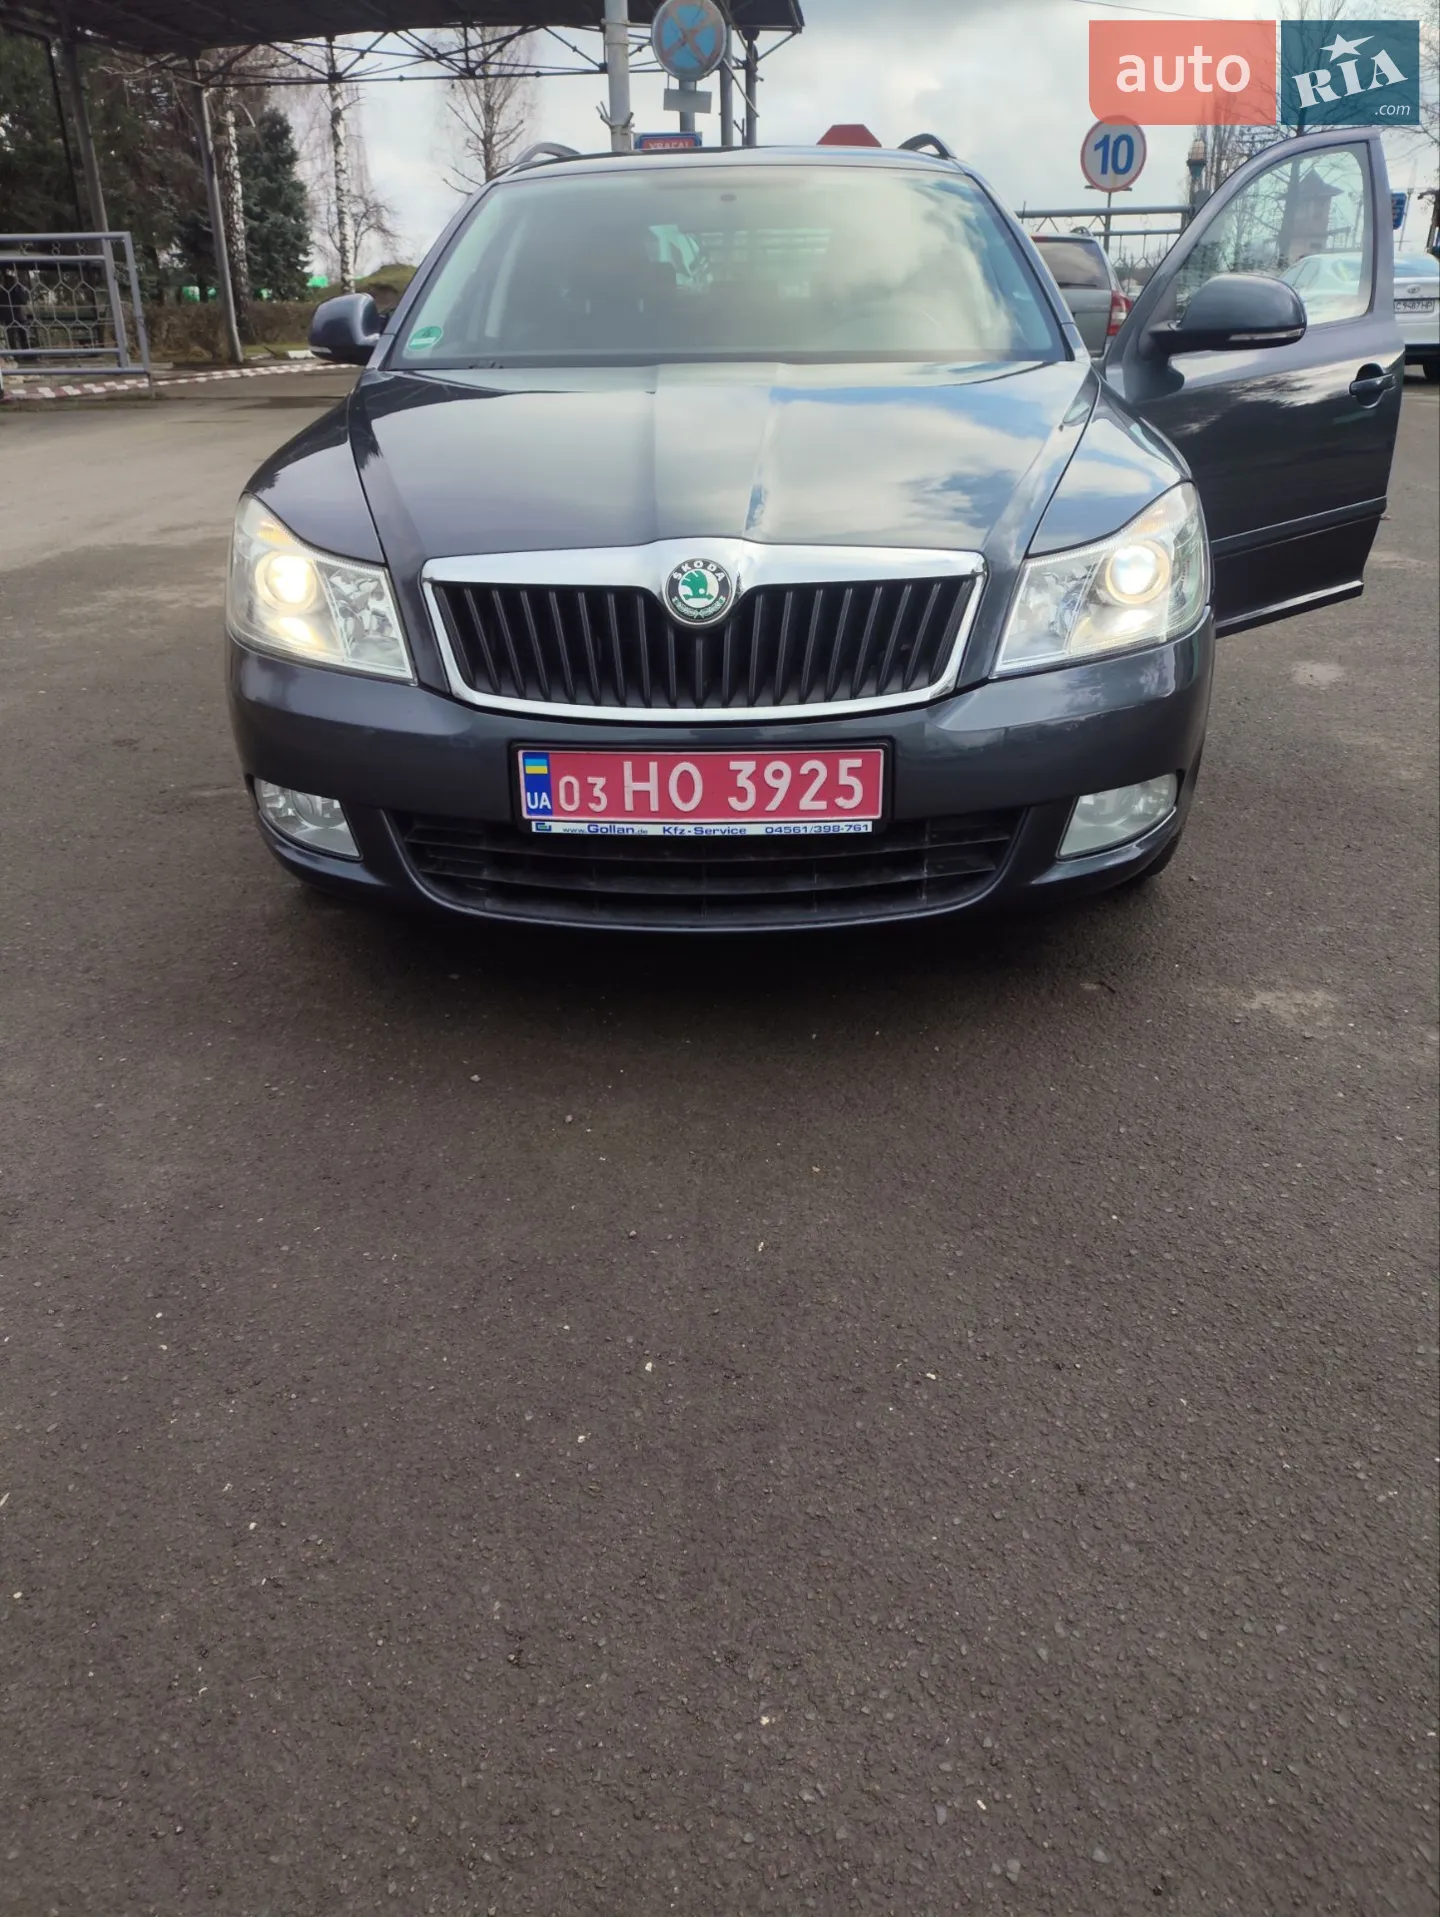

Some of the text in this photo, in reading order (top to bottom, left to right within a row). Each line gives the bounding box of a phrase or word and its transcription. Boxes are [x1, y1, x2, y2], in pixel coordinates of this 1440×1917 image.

[1093, 133, 1135, 176] 10
[527, 791, 552, 810] UA
[558, 758, 864, 812] 03 HO 3925
[562, 823, 649, 836] www.Gollan.de
[765, 823, 869, 835] 04561/398-761
